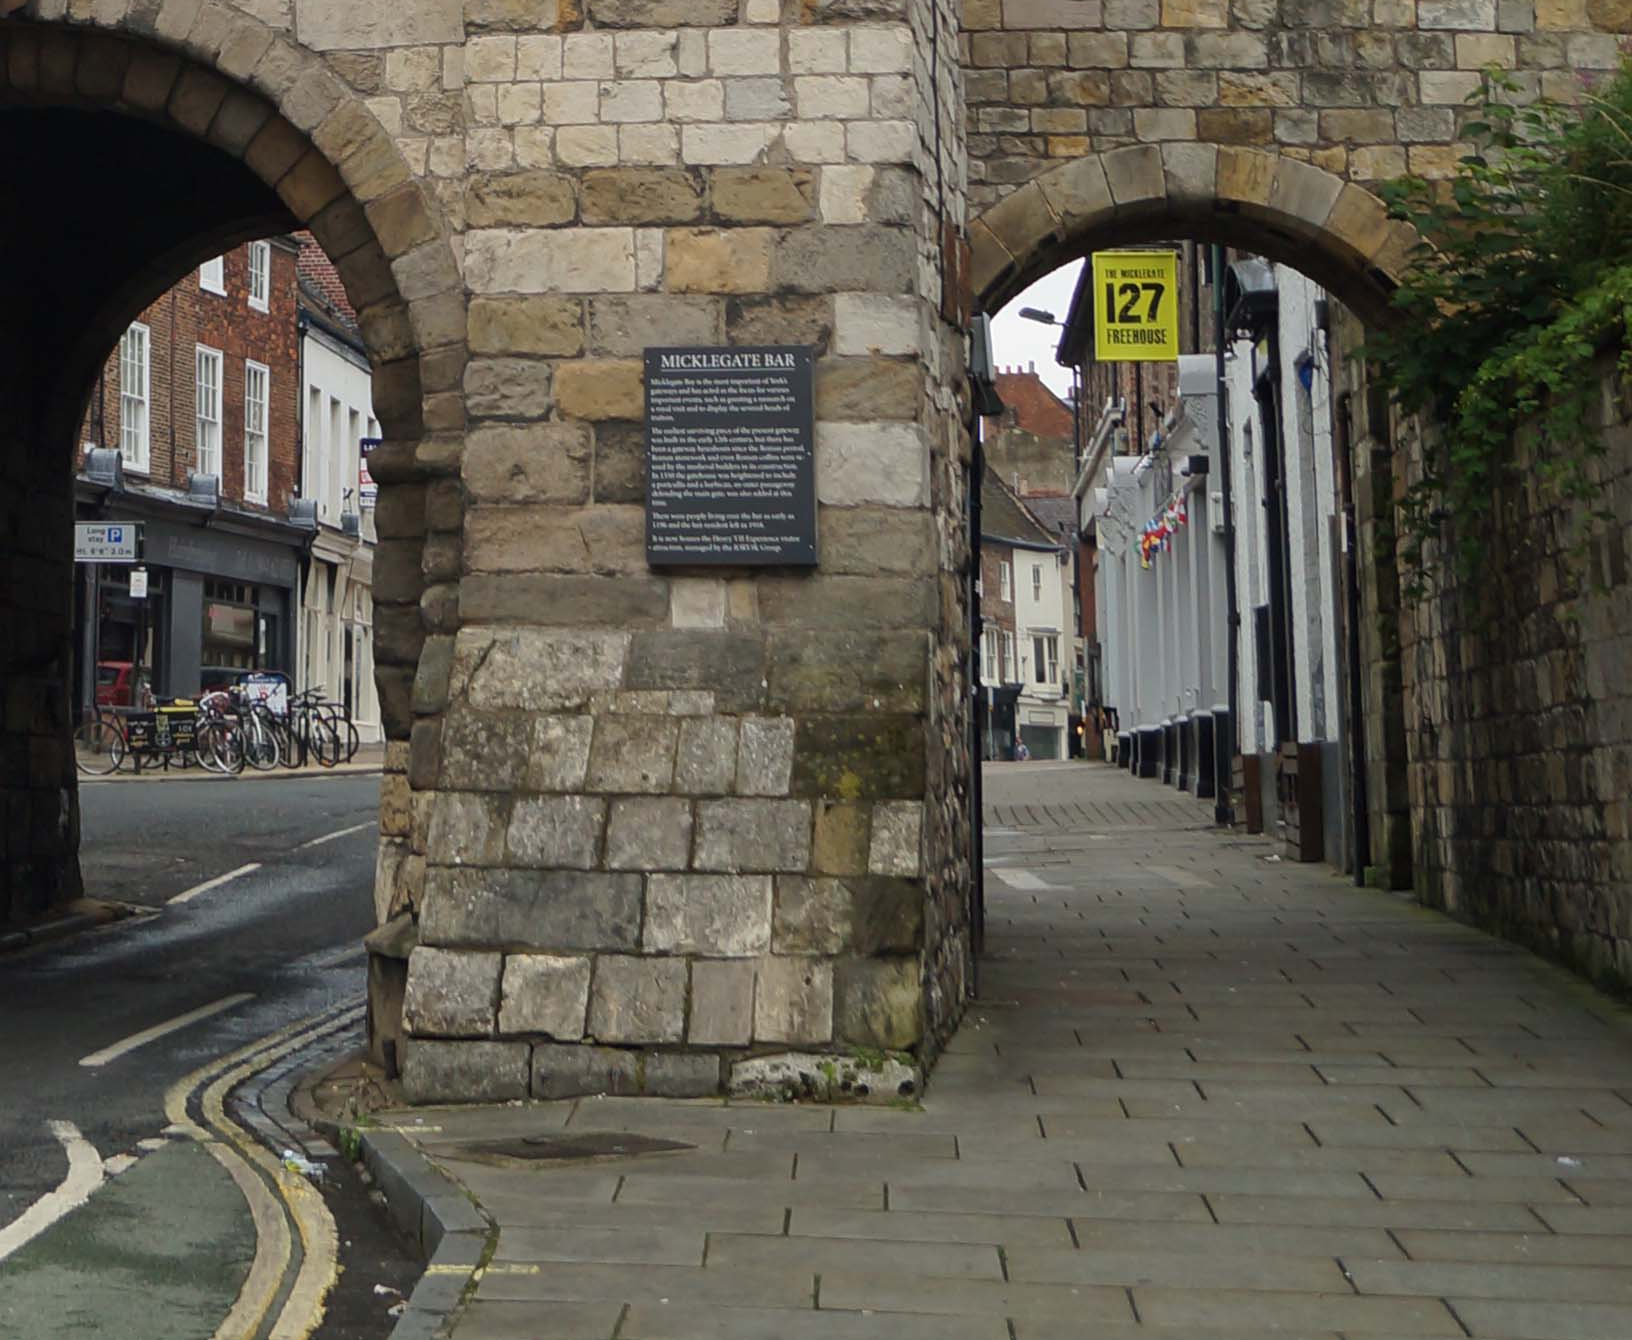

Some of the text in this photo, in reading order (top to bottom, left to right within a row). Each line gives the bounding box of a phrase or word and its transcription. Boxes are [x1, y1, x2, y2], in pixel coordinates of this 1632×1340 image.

[1105, 268, 1165, 279] THE MICKLEGATE
[1105, 282, 1165, 323] 127
[1106, 327, 1167, 345] FREEHOUSE
[661, 353, 795, 368] MICKLEGATE BAR
